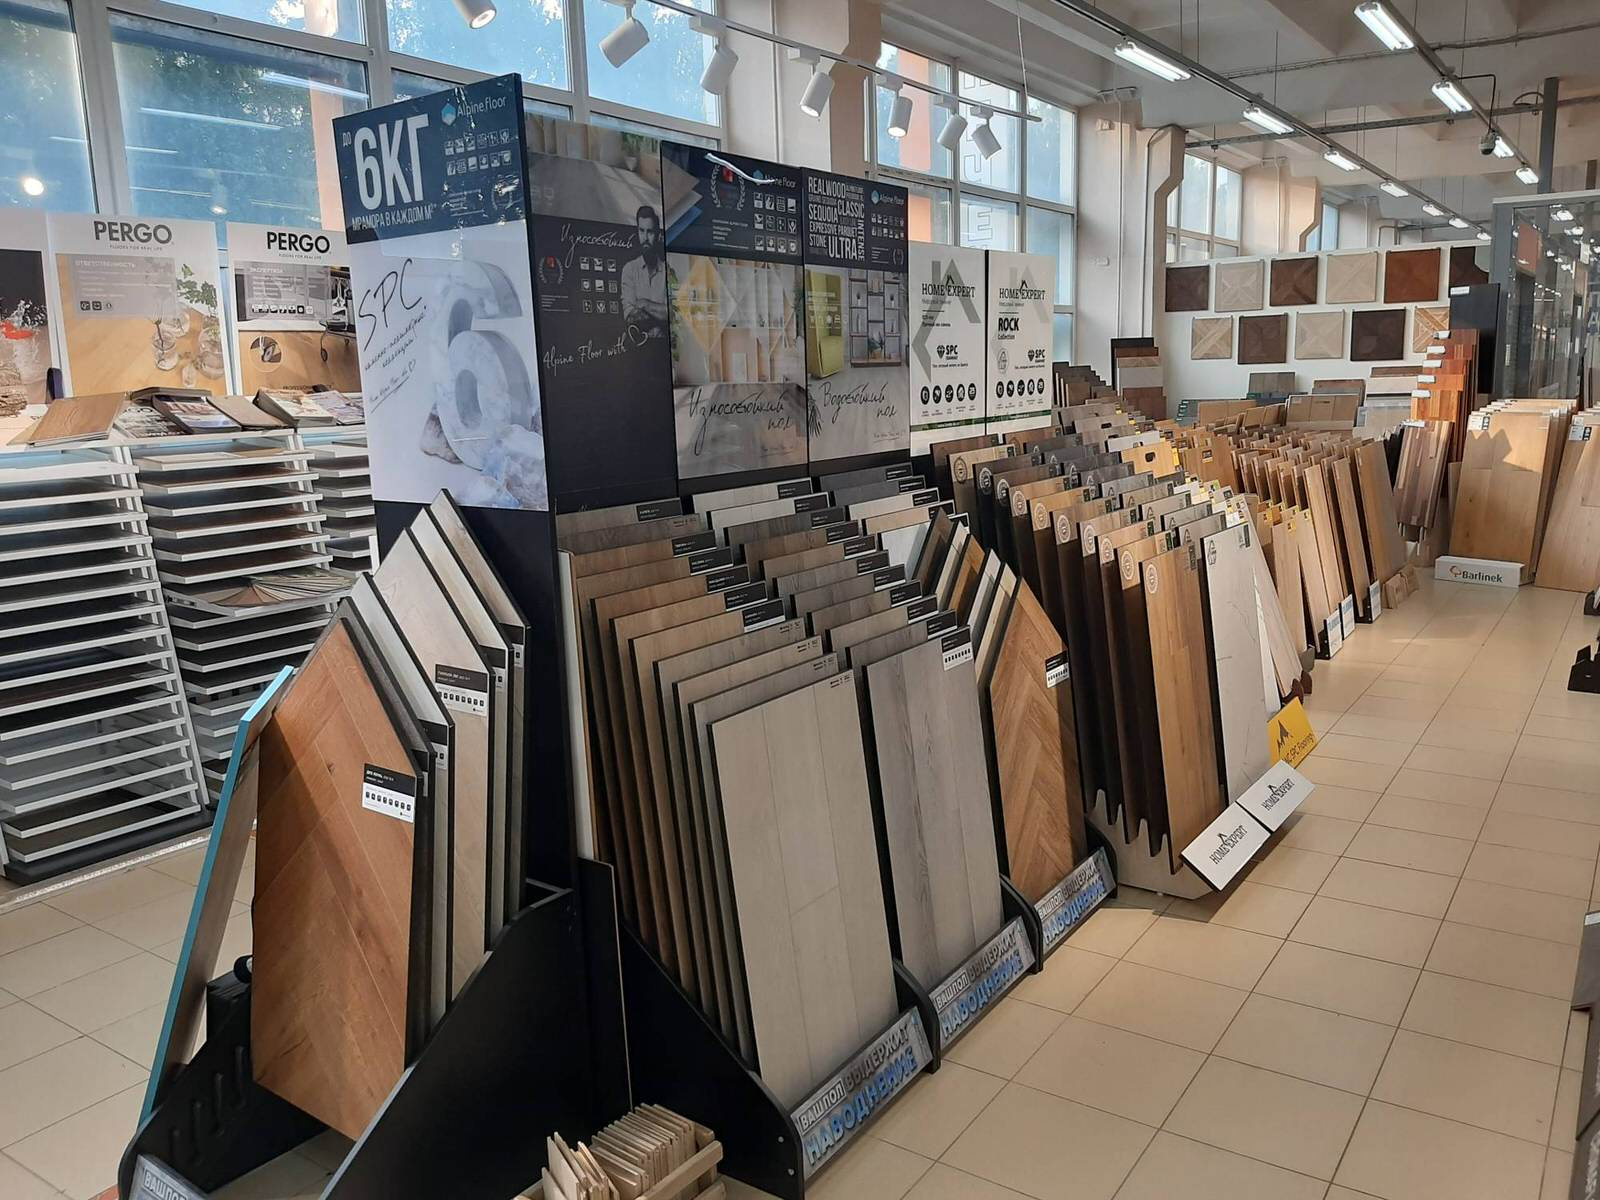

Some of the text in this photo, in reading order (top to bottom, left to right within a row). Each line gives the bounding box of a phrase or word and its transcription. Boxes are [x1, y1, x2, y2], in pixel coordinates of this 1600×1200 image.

[342, 131, 352, 148] ДО
[354, 113, 430, 211] 6КГ
[808, 176, 846, 199] REALWOOD
[352, 211, 386, 231] МРАМОРА
[385, 212, 392, 226] В
[391, 205, 425, 225] КАЖДОМ
[808, 203, 839, 223] SEQUOIA
[837, 199, 865, 219] CLASSIC
[93, 220, 172, 244] PERGO
[809, 221, 838, 236] EXPRESSIVE
[857, 219, 865, 262] INTENSE
[266, 231, 330, 254] PERGO
[809, 233, 827, 248] STONE
[828, 235, 858, 260] ULTRA
[921, 283, 976, 299] HOME EXPERT
[999, 287, 1046, 301] HOME EXPERT
[358, 258, 423, 352] SPC
[998, 317, 1019, 332] ROCK
[542, 331, 627, 377] Alpine Floor with
[945, 344, 959, 356] SPC
[1034, 349, 1046, 359] SPC
[1462, 570, 1504, 583] Barlinek
[1261, 778, 1296, 811] HOME EXPERT
[1209, 824, 1249, 865] HOME EXPERT
[1043, 874, 1106, 945] НАВОДНЕНИЕ
[967, 932, 1018, 983] ВЫДЕРЖИТ
[939, 951, 1024, 1040] НАВОДНЕНИЕ
[845, 1023, 910, 1092] ВЫДЕРЖИТ
[804, 1046, 919, 1166] НАВОДНЕНИЕ
